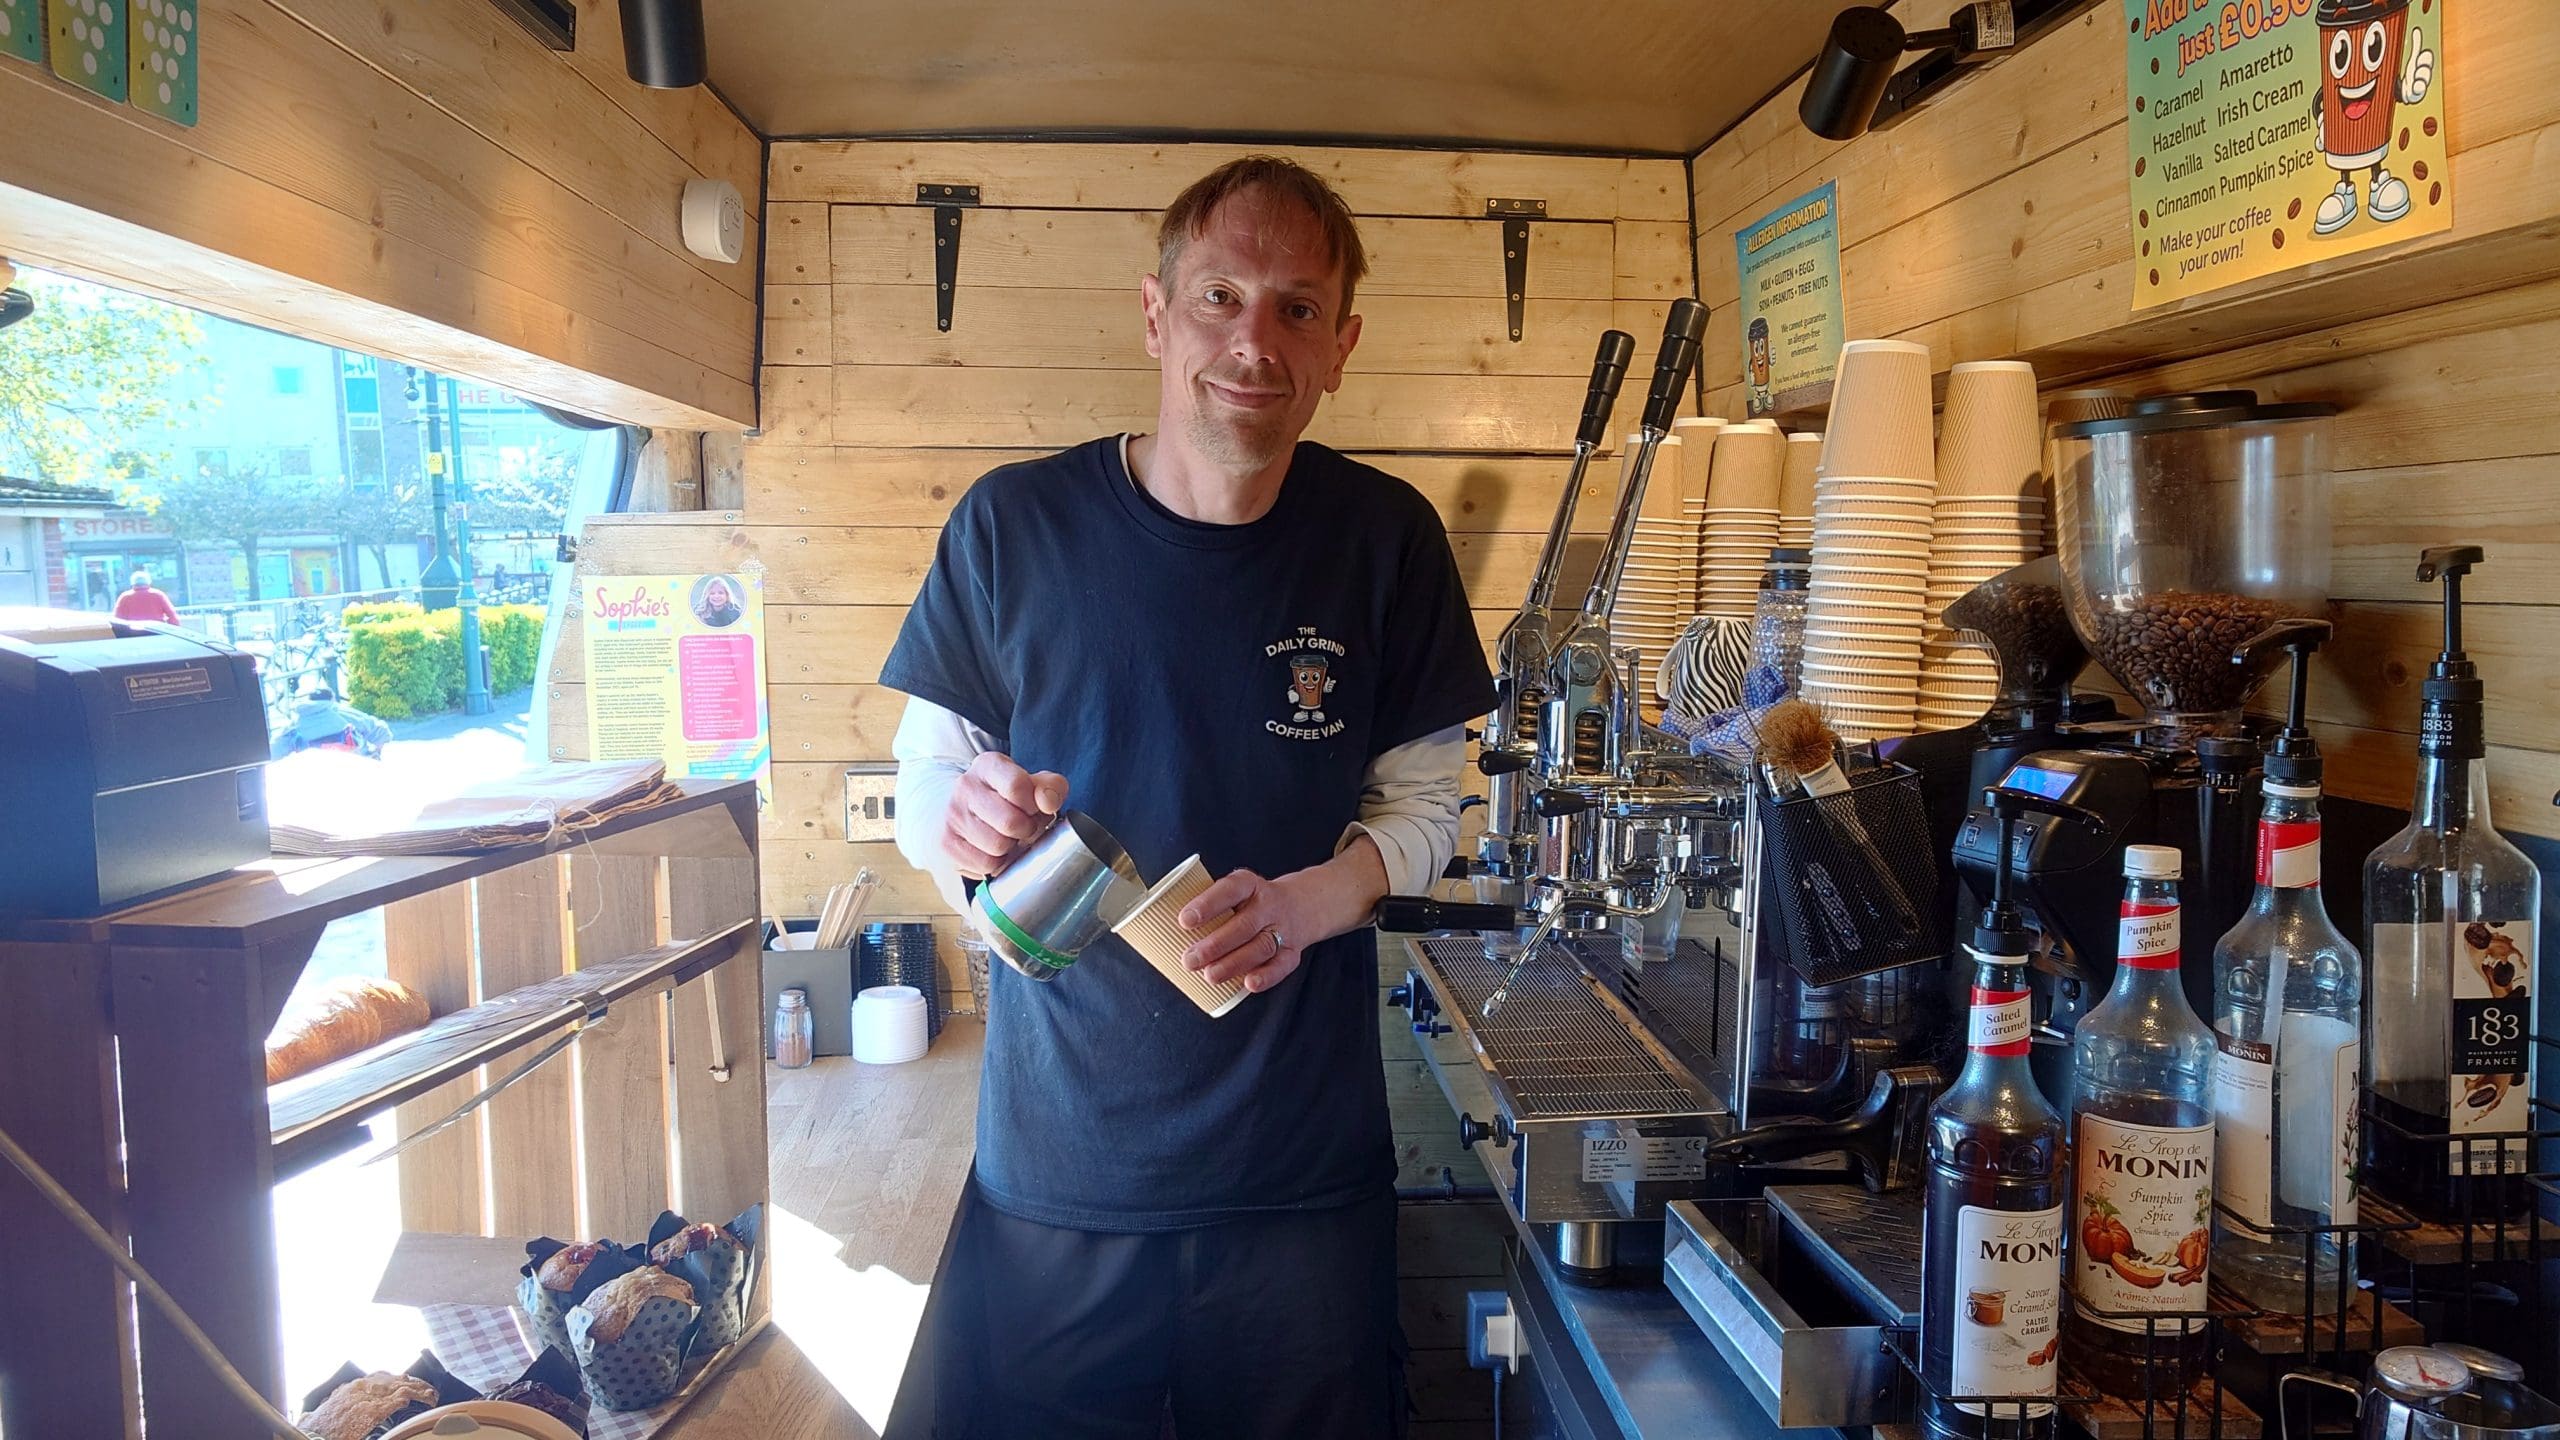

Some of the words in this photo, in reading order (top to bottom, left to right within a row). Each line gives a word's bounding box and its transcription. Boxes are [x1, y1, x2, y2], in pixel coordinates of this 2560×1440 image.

[2177, 23, 2215, 78] just
[2219, 44, 2294, 91] Amaretto
[2154, 79, 2204, 120] Caramel
[2217, 98, 2249, 128] Irish
[2252, 79, 2304, 112] Cream
[2153, 116, 2207, 154] Hazelnut
[2214, 131, 2255, 163] Salted
[2257, 108, 2311, 147] Caramel
[2162, 153, 2204, 183] Vanilla
[2220, 161, 2276, 195] Pumpkin
[2278, 149, 2314, 178] Spice
[2156, 184, 2216, 218] Cinnamon
[1747, 221, 1776, 256] ALLERGEN
[1776, 197, 1829, 239] INFORMATION
[2160, 230, 2193, 256] Make
[2196, 222, 2226, 249] your
[2229, 207, 2272, 234] coffee
[2179, 252, 2209, 279] your
[2211, 238, 2244, 265] own!
[1760, 277, 1771, 293] MILK
[1775, 267, 1794, 286] GLUTEN
[1798, 259, 1815, 276] EGGS
[1772, 288, 1794, 307] PEANUTS
[1798, 282, 1812, 296] TREE
[1812, 275, 1828, 291] NUTS
[593, 586, 669, 632] Sophie's
[1297, 627, 1317, 635] THE
[1265, 638, 1305, 657] DAILY
[1307, 638, 1345, 657] GRIND
[1265, 720, 1320, 740] COFFEE
[1320, 719, 1345, 738] VAN
[2423, 719, 2453, 731] 1883
[2127, 921, 2172, 936] Pumpkin
[2137, 937, 2166, 951] Spice
[1983, 1017, 2027, 1037] Caramel
[1986, 1008, 2021, 1024] Salted
[2227, 1045, 2266, 1061] MONIN
[2467, 1057, 2518, 1066] FRANCE
[1592, 1140, 1627, 1151] IZZO
[2111, 1134, 2139, 1152] Le
[2141, 1136, 2184, 1160] Sirop
[2187, 1144, 2201, 1154] de
[2097, 1149, 2208, 1179] MONIN
[2128, 1187, 2183, 1208] Pumpkin
[2140, 1206, 2174, 1225] Spice
[1996, 1221, 2023, 1239] Le
[2025, 1219, 2057, 1241] Sirop
[1980, 1237, 2059, 1264] MONI
[2009, 1300, 2045, 1314] Caramel
[2114, 1289, 2149, 1303] Arômes
[2021, 1325, 2050, 1336] CARAMEL
[2025, 1316, 2048, 1327] SALTED
